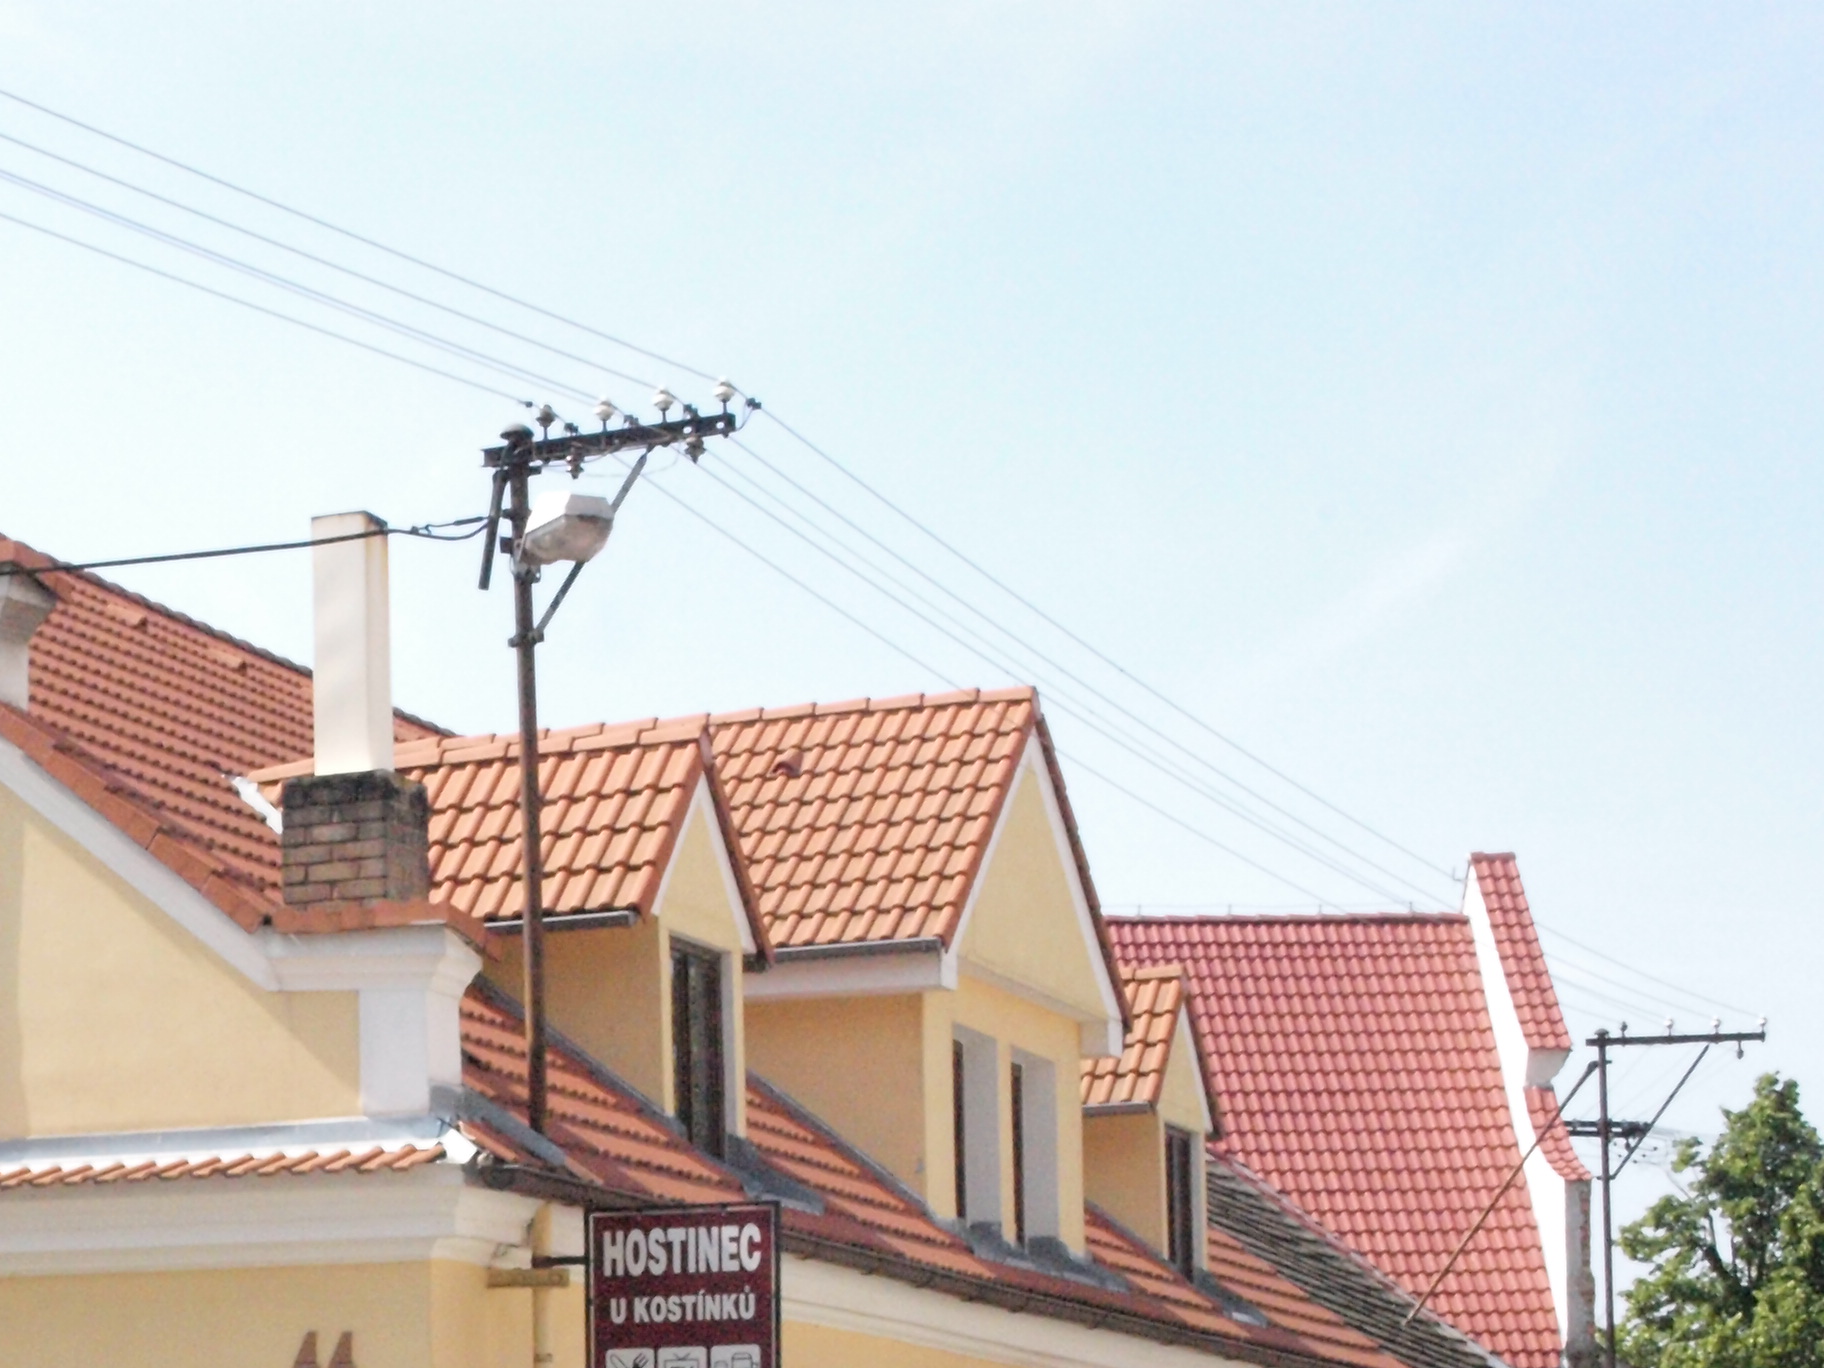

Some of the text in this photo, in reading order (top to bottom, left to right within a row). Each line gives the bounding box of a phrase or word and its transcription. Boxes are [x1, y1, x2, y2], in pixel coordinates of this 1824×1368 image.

[603, 1222, 762, 1277] HOSTINEC
[610, 1285, 756, 1324] U KOSTÍNKŮ
